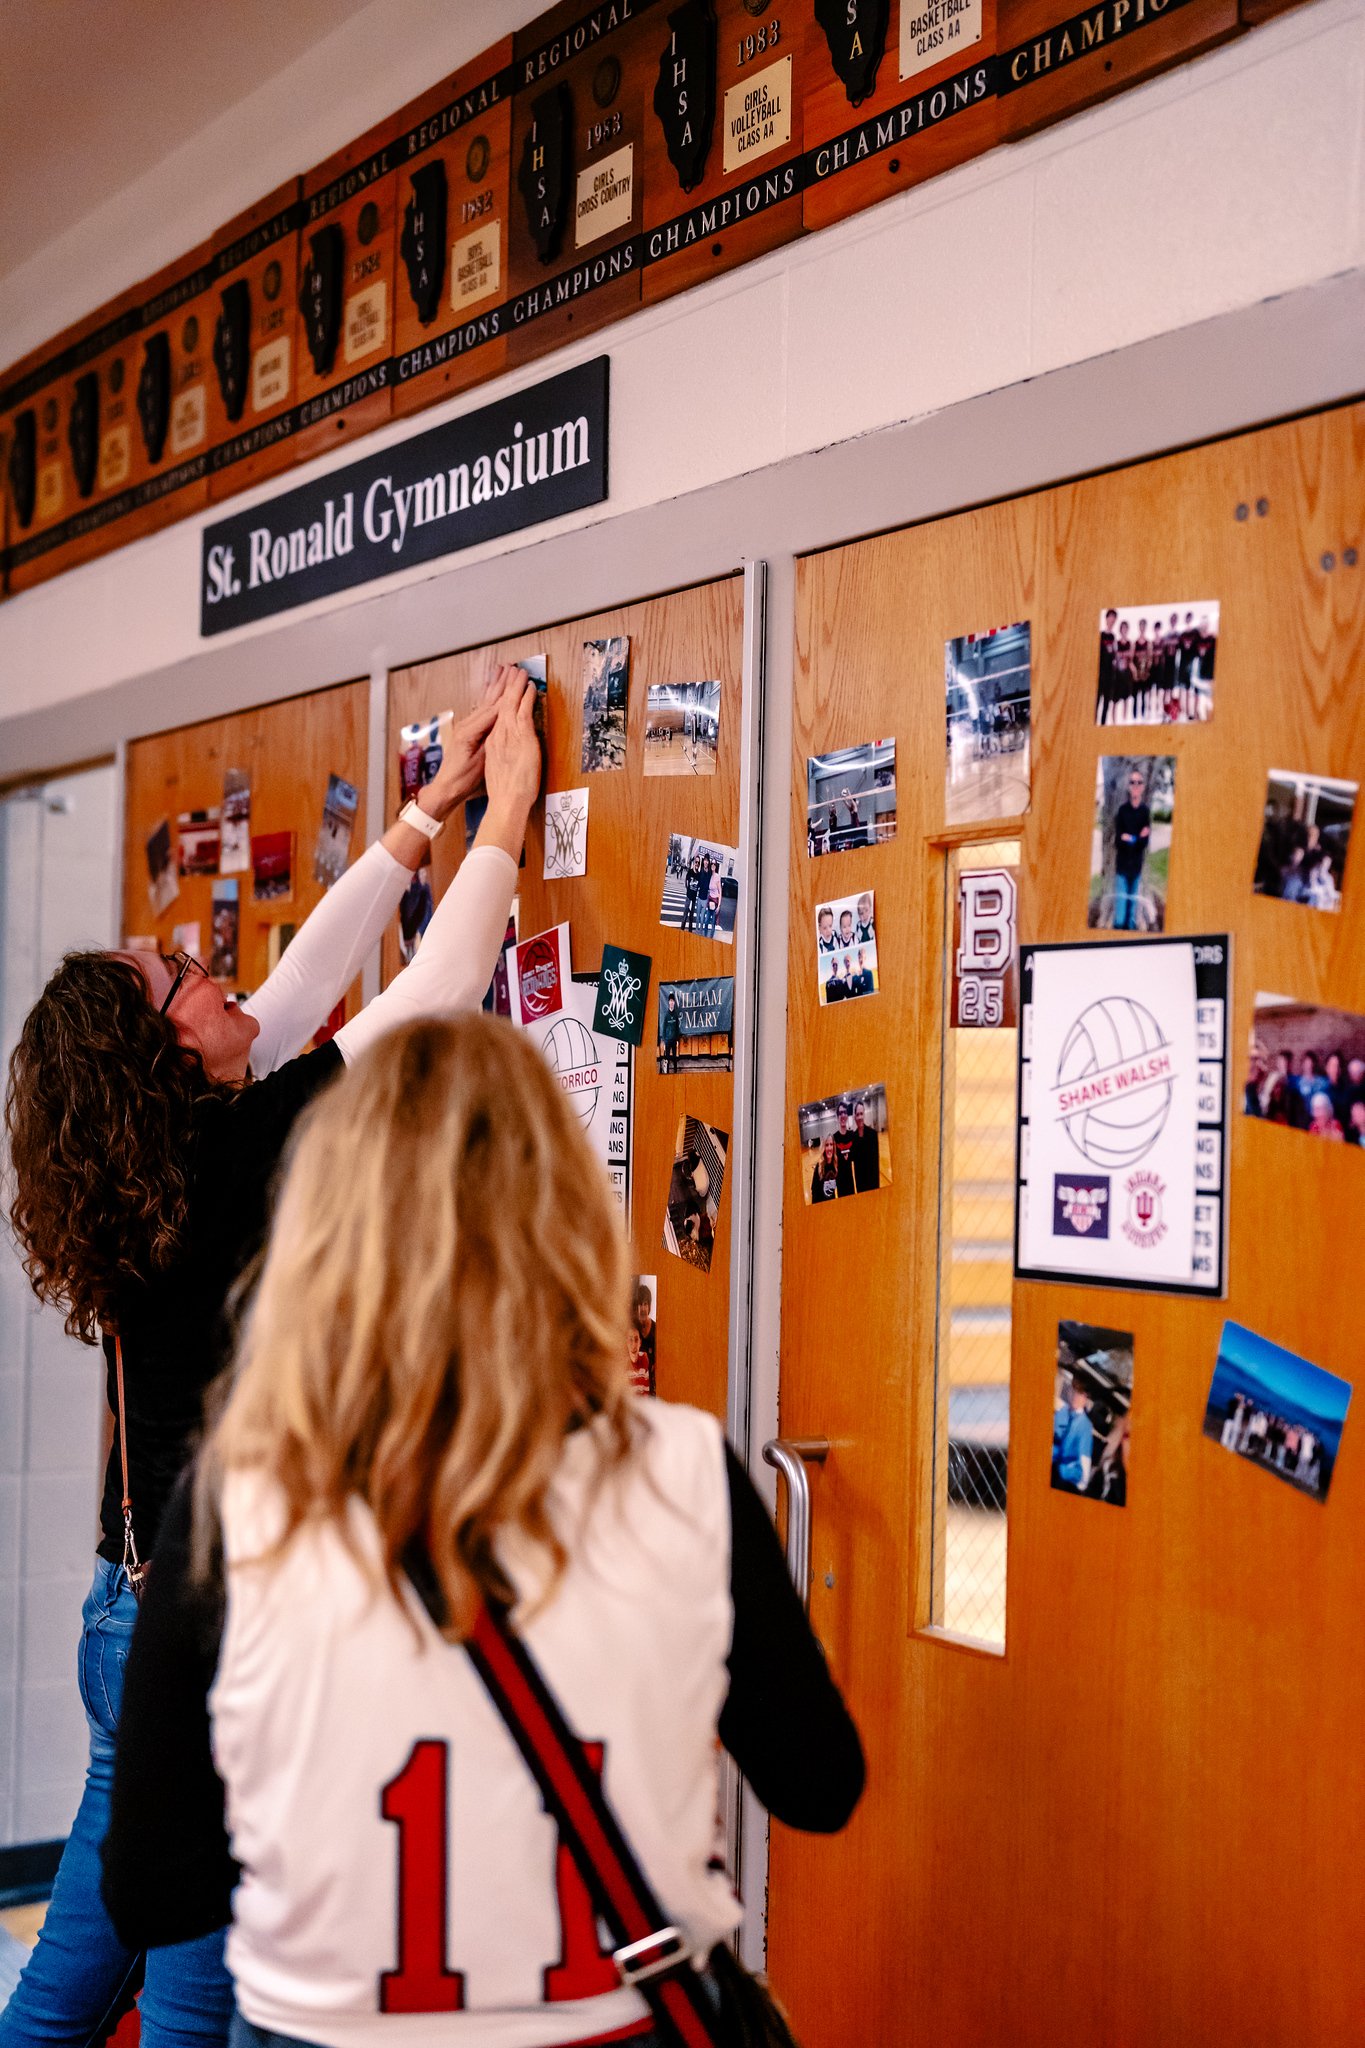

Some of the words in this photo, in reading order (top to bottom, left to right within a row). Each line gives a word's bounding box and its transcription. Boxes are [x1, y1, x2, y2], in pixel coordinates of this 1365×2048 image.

[524, 0, 633, 83] REGIONAL
[737, 20, 780, 67] 1983
[910, 0, 971, 39] BASKETBALL
[917, 27, 944, 56] CLASS
[948, 19, 960, 40] AA
[671, 32, 692, 146] IHSA
[745, 85, 768, 112] GIRLS
[408, 79, 500, 154] REGIONAL
[731, 96, 781, 137] VOLLEYBALL
[738, 129, 760, 152] CLASS
[763, 121, 774, 140] AA
[815, 69, 987, 176] CHAMPIONS
[577, 193, 598, 218] CROSS
[600, 174, 631, 205] COUNTRY
[593, 167, 614, 193] GIRLS
[650, 168, 794, 257] CHAMPIONS
[513, 246, 633, 323] CHAMPIONS
[400, 313, 499, 379] CHAMPIONS
[206, 545, 241, 604] St.
[248, 492, 354, 589] Ronald
[363, 415, 591, 553] Gymnasium
[957, 869, 1017, 978] B
[685, 1011, 720, 1028] MARY
[958, 975, 1004, 1027] 25
[1058, 1076, 1112, 1111] SHANE
[1115, 1054, 1171, 1089] WALSH
